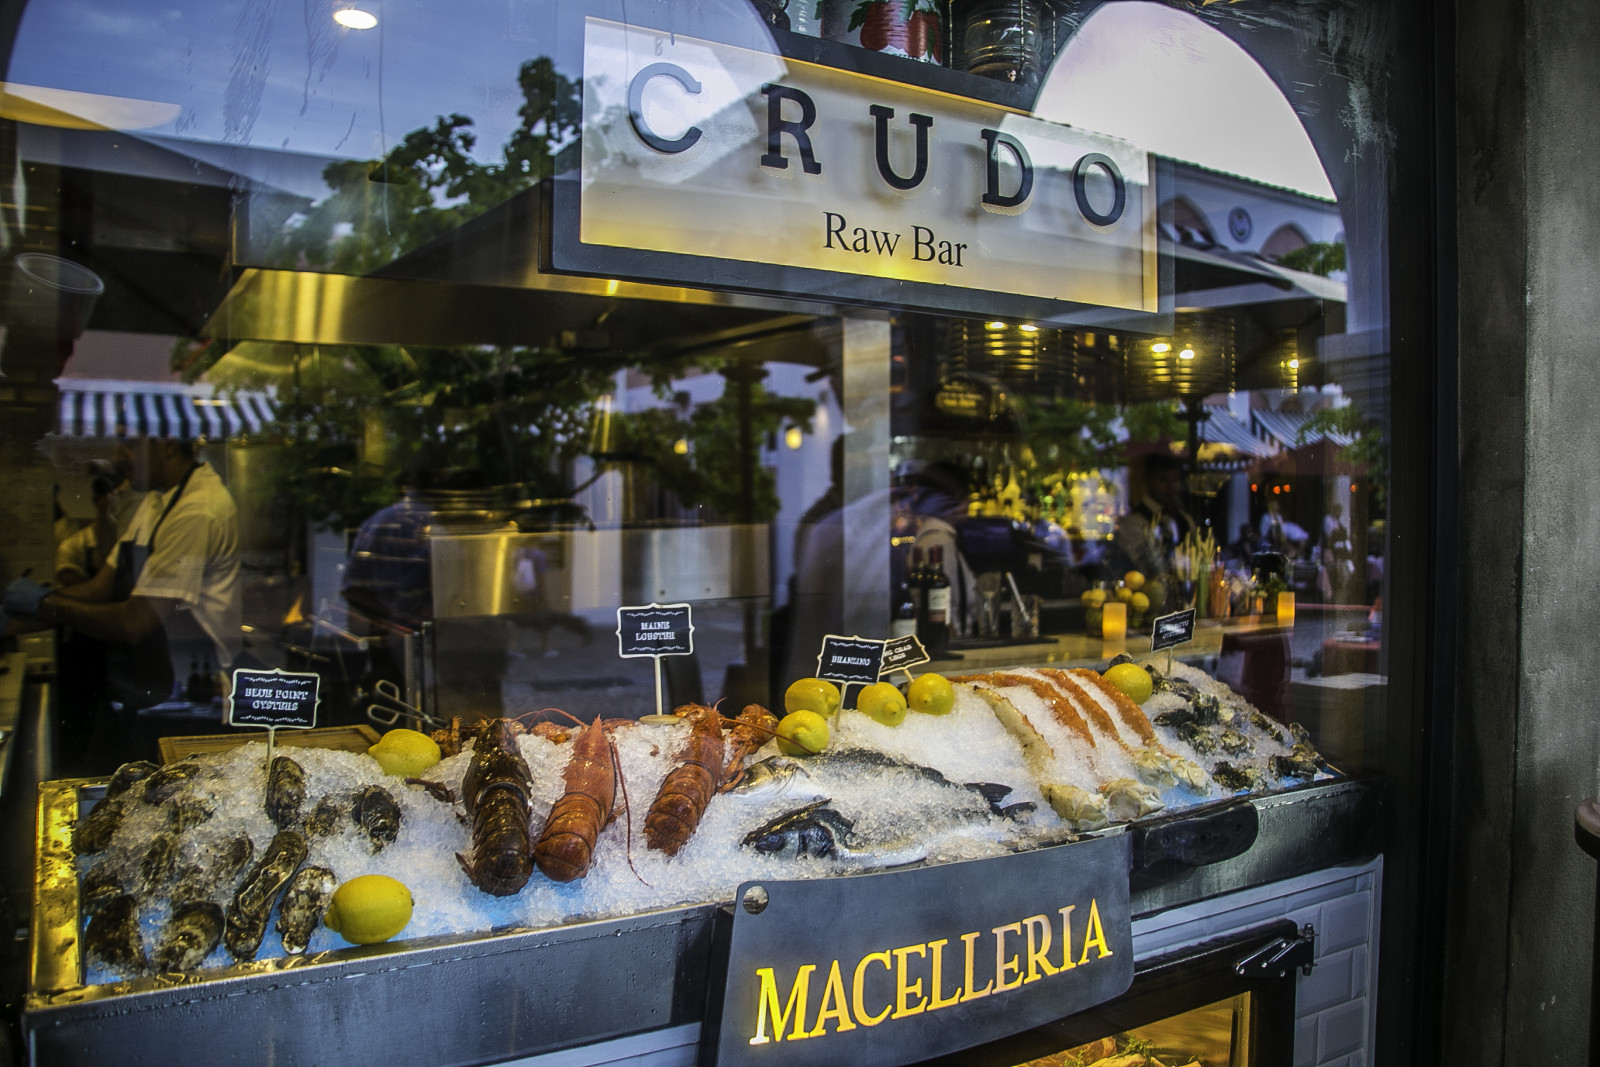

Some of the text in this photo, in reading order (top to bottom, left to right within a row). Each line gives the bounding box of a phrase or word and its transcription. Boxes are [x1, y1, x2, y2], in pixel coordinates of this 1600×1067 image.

[628, 62, 1127, 227] CRUDO
[822, 211, 968, 267] Raw Bar
[640, 621, 671, 630] MAINE
[635, 632, 676, 641] LOBSTER
[894, 644, 913, 654] CRAB
[831, 655, 871, 666] BRANZINO
[888, 652, 906, 661] LEGS
[244, 687, 308, 700] BLUE POINT
[252, 699, 299, 711] OYSTERS
[749, 898, 1112, 1046] MACELLERIA
